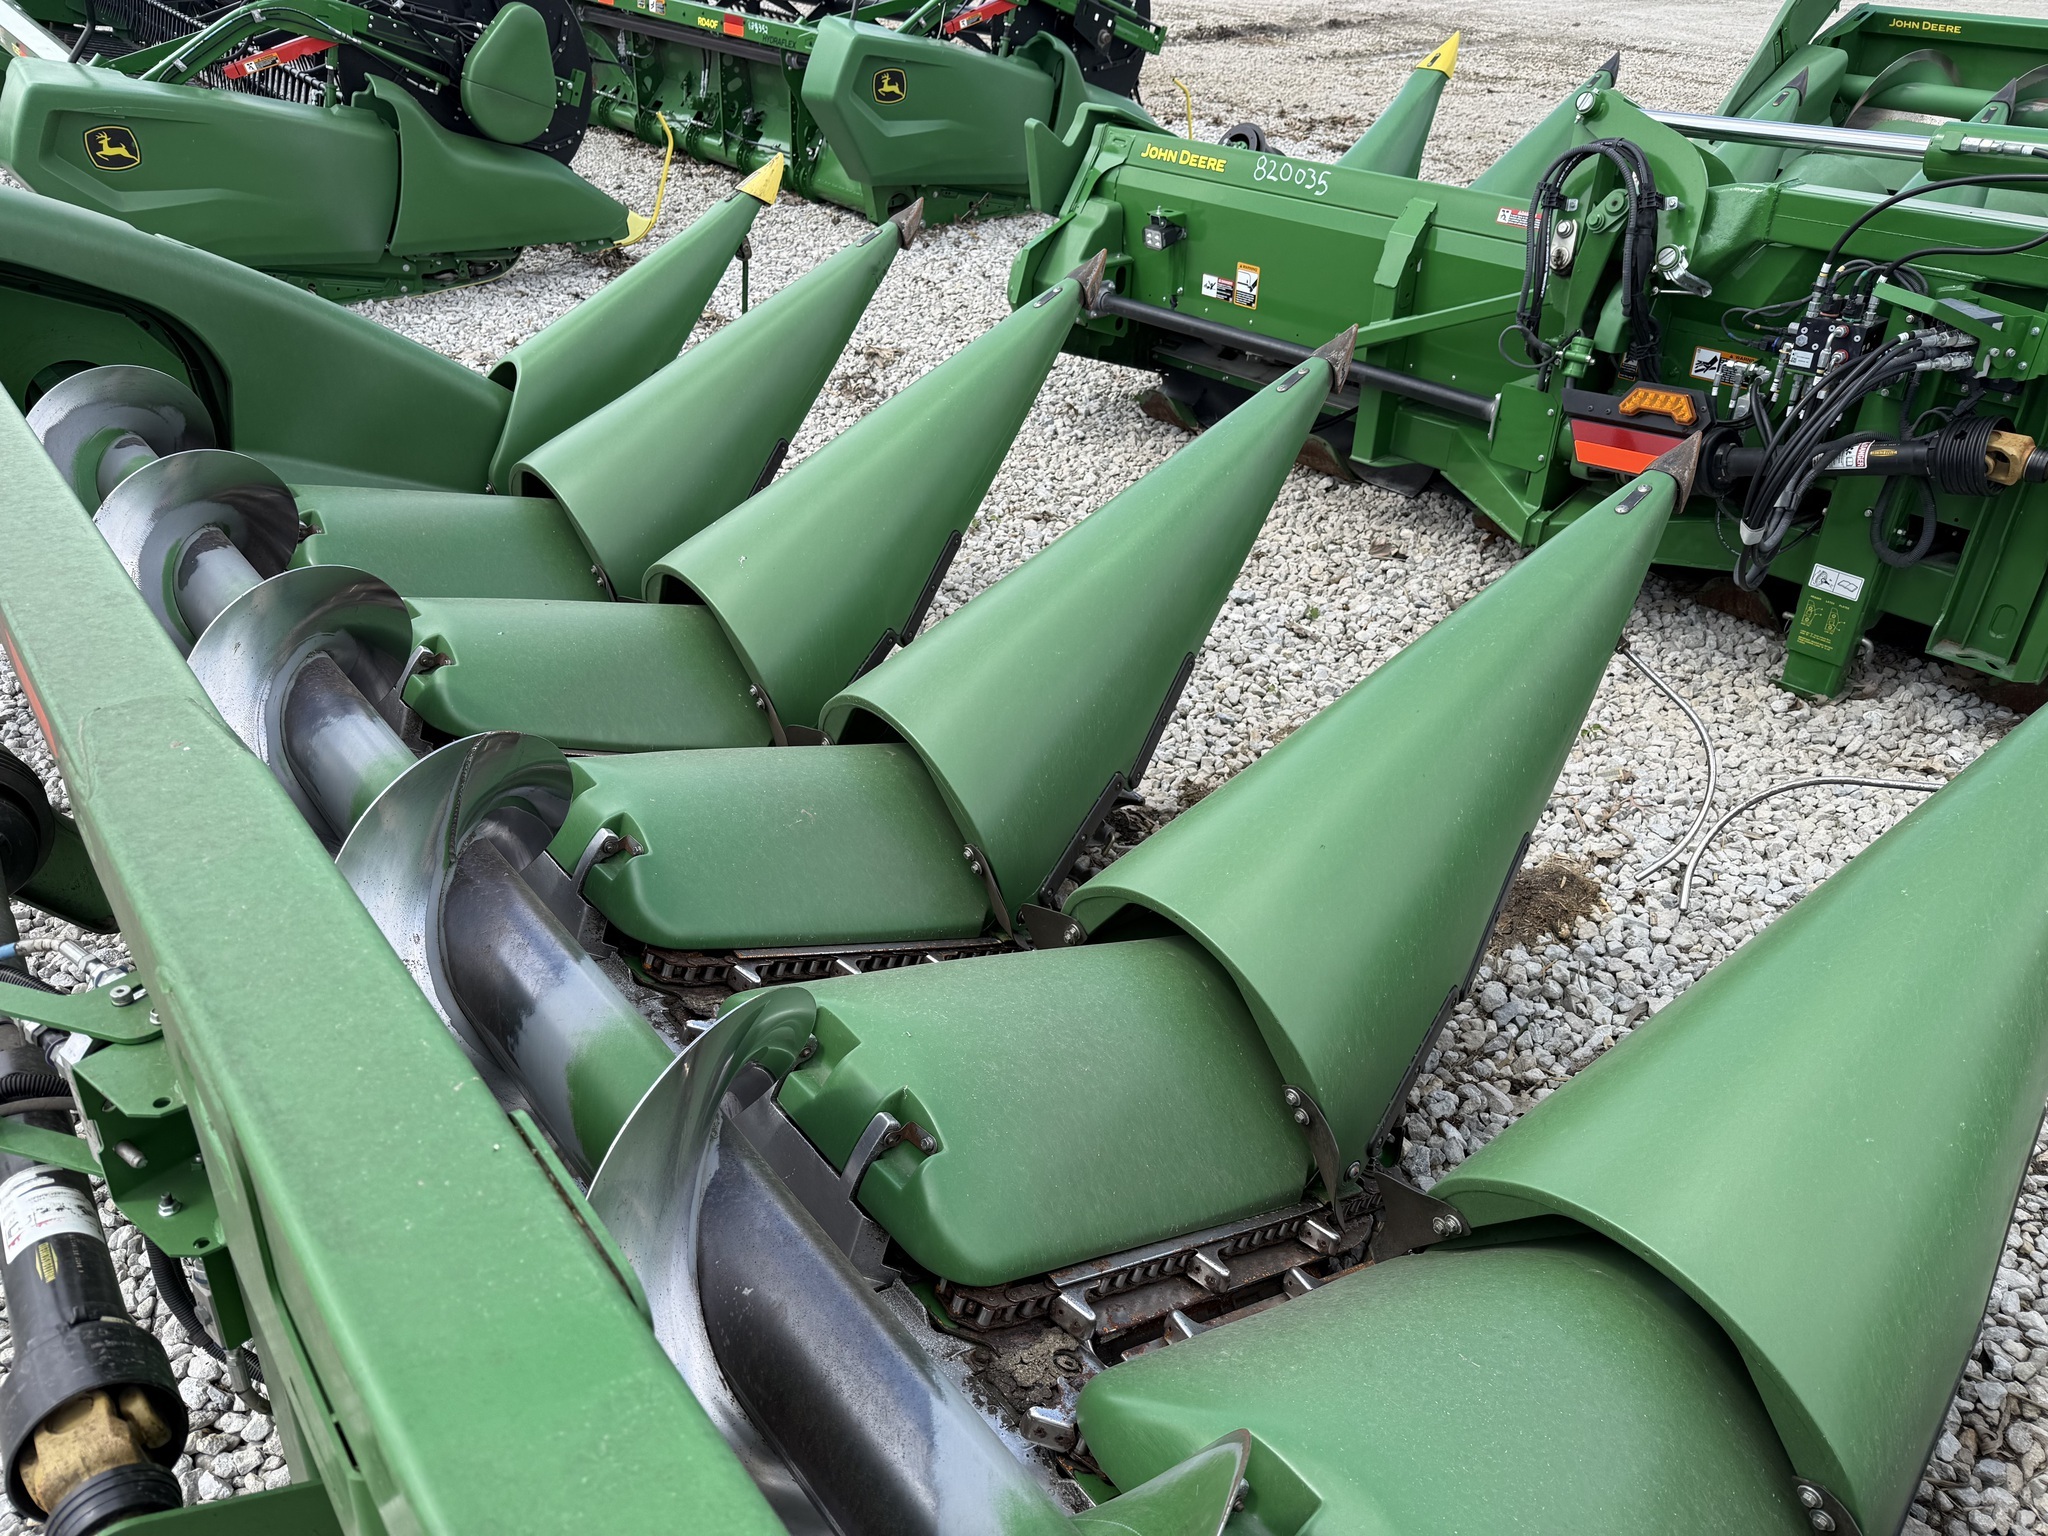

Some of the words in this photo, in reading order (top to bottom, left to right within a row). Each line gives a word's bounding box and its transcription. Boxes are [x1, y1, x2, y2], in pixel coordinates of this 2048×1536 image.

[697, 16, 719, 29] RD40F
[1889, 17, 1920, 30] JOHN
[1921, 20, 1962, 34] DEERE
[762, 33, 797, 50] HYDRAFLEX
[1140, 143, 1179, 163] JOHN
[1178, 149, 1227, 173] DEERE
[1253, 155, 1332, 196] 820035
